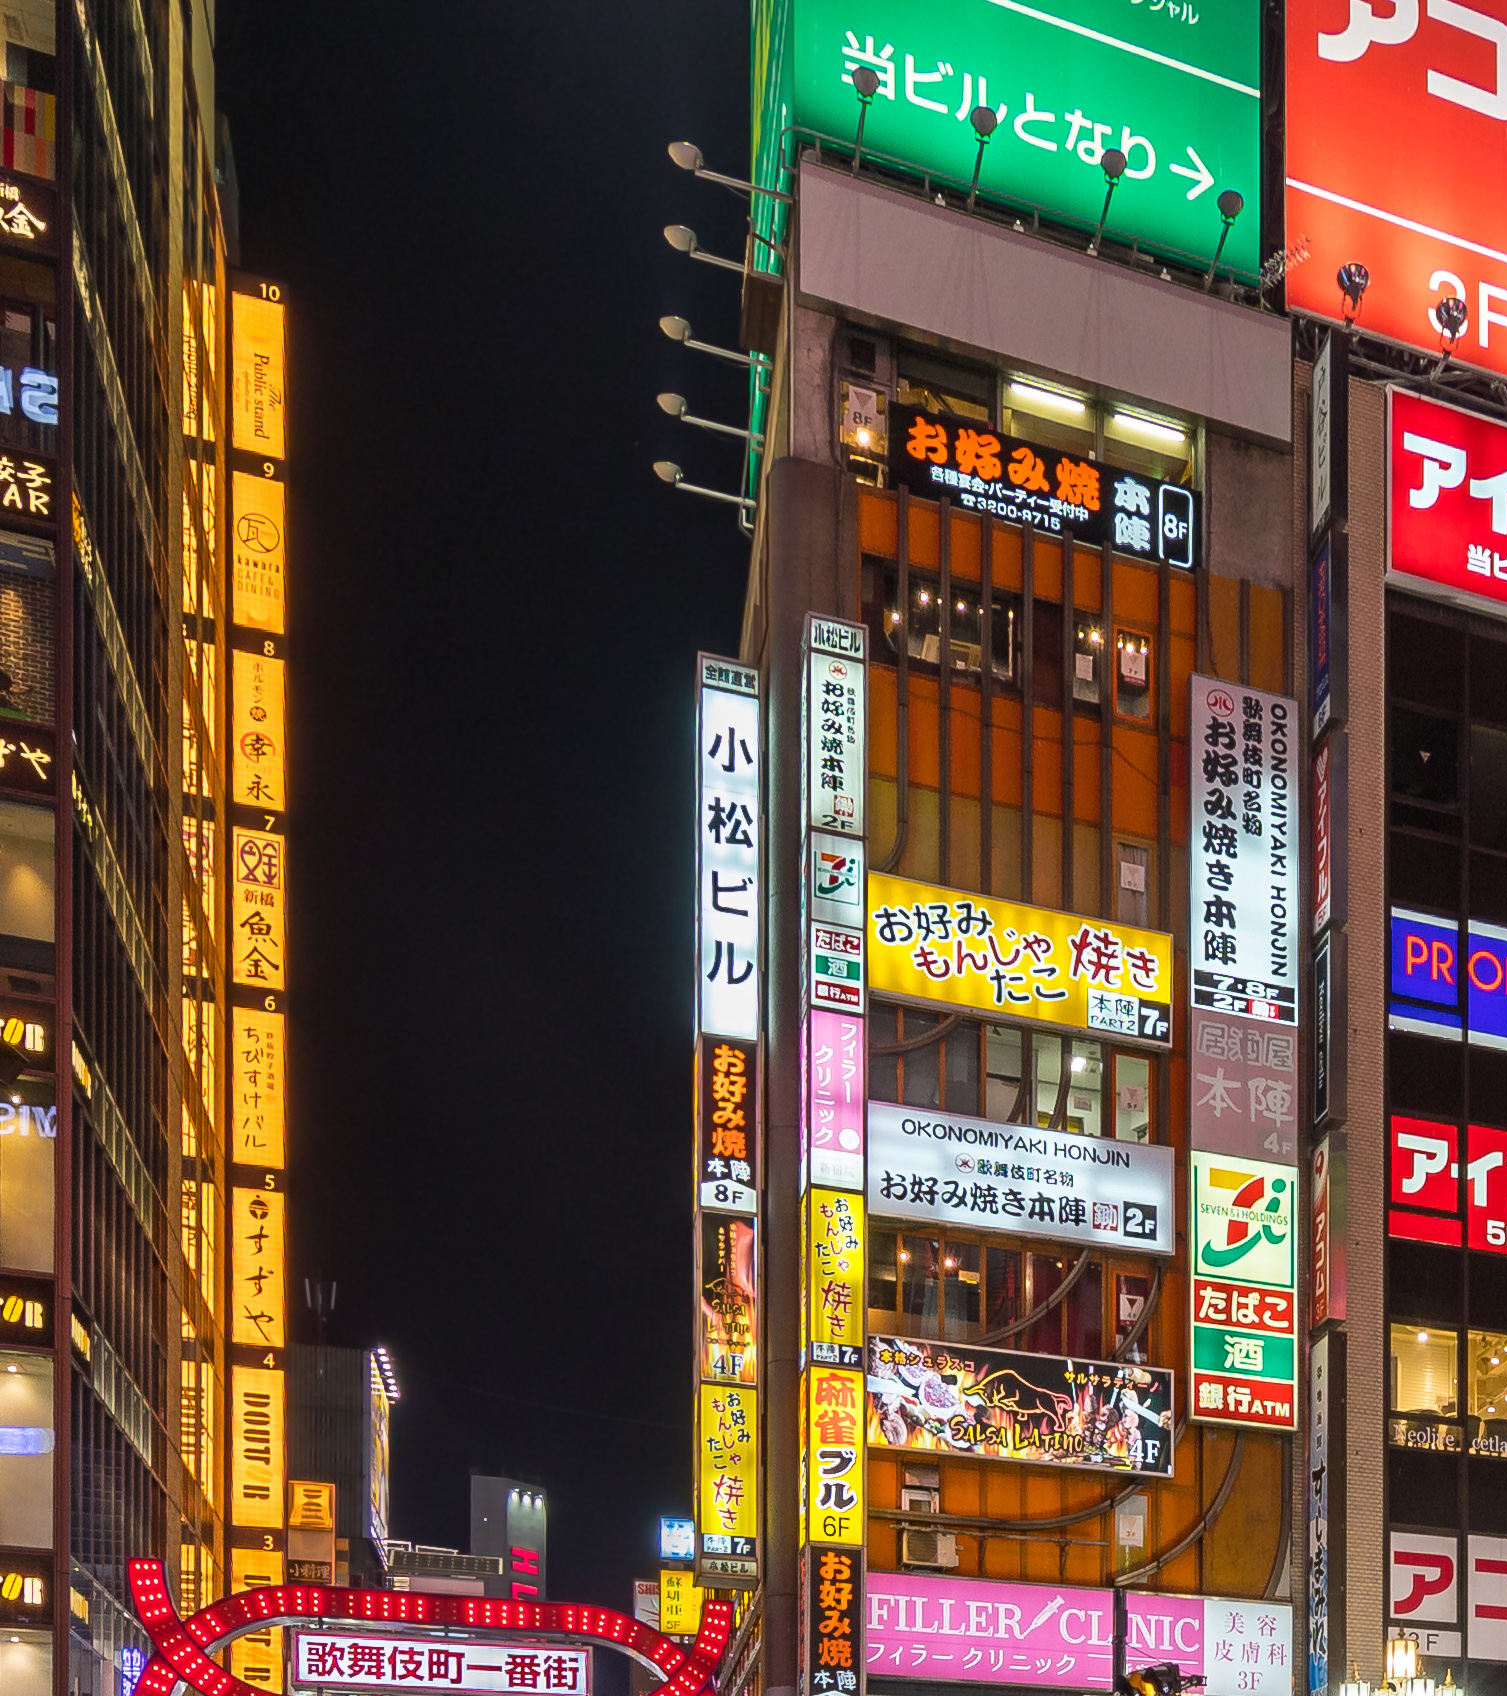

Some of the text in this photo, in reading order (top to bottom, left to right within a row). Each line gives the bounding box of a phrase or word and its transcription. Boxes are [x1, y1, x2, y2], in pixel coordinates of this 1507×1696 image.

[840, 31, 1157, 181] 当ビルとなり
[260, 284, 280, 300] 10
[255, 352, 269, 439] Public stand
[906, 414, 1101, 511] お好み焼
[1162, 512, 1189, 541] 8F
[238, 555, 280, 574] kawara
[814, 623, 861, 654] 小松ビル
[821, 814, 854, 831] 2F
[708, 726, 754, 986] 小松ビル
[1202, 716, 1239, 965] お好み焼き本陣
[1270, 703, 1288, 978] OKONOMIYAKI HONJIN
[243, 888, 275, 908] 新橋
[240, 911, 279, 981] 魚金
[816, 929, 861, 954] たばこ
[1070, 927, 1158, 989] 焼き
[827, 957, 848, 977] 酒
[1213, 994, 1247, 1011] 2F
[1140, 1006, 1168, 1037] 7F
[841, 1022, 858, 1103] フィラー
[243, 1027, 267, 1148] ちびすけバル
[713, 1044, 747, 1158] お好み焼
[814, 1044, 834, 1147] クリニック
[901, 1118, 1131, 1168] OKONOMIYAKI HONJIN
[707, 1160, 751, 1181] 本陣
[714, 1184, 744, 1204] 8F
[879, 1168, 1089, 1227] お好み焼き本陣
[1124, 1208, 1156, 1237] 2F
[1241, 1209, 1288, 1226] HOLDINGS
[244, 1225, 274, 1342] すずや
[821, 1281, 852, 1338] 焼き
[1198, 1285, 1290, 1328] たばこ
[713, 1355, 744, 1376] 4F
[841, 1347, 859, 1364] 7F
[879, 1348, 976, 1374] 本格シュラスコ
[1198, 1381, 1290, 1418] 銀行ATM
[243, 1392, 271, 1500] DOUTOR
[814, 1373, 857, 1511] 麻雀ブル
[950, 1417, 1085, 1454] SALSA LATINO
[1129, 1439, 1163, 1465] 4F
[713, 1474, 744, 1530] 焼き
[823, 1516, 850, 1537] 6F
[734, 1538, 751, 1554] 7F
[867, 1593, 1201, 1654] FILLER CLNIC
[1223, 1611, 1279, 1635] 美容
[305, 1643, 581, 1690] 歌舞伎町一番街
[867, 1642, 1077, 1676] フィラー クリニック
[1214, 1639, 1288, 1665] 皮膚科
[814, 1671, 857, 1689] 本陣
[1237, 1670, 1264, 1691] 3F
